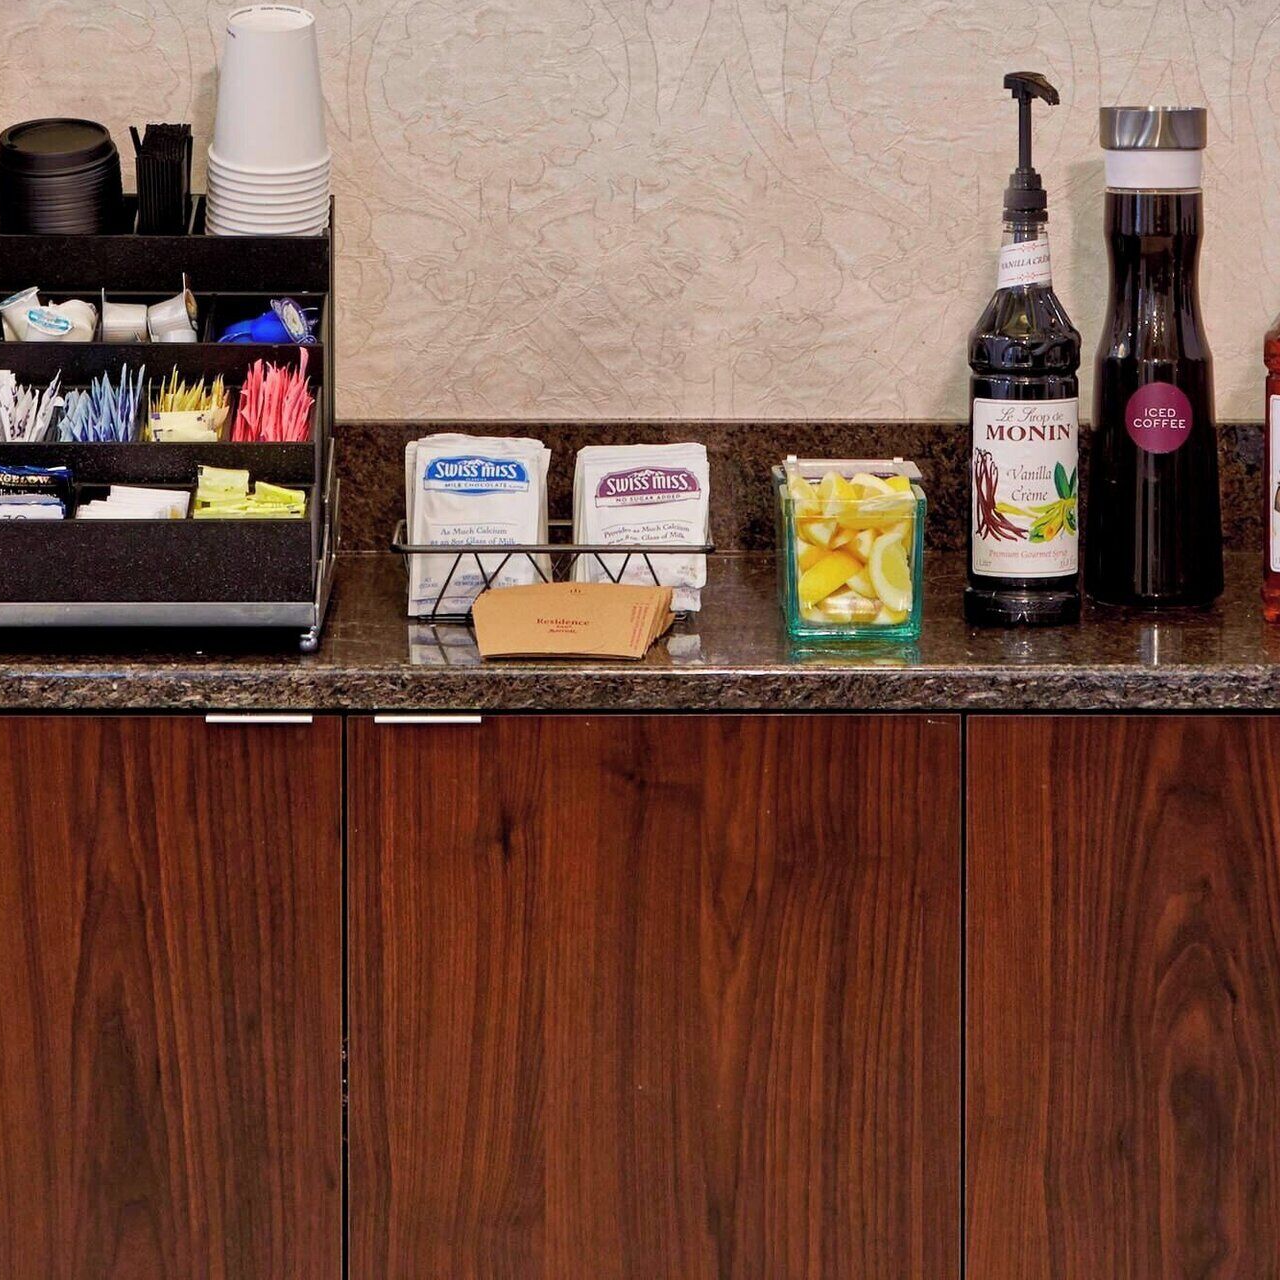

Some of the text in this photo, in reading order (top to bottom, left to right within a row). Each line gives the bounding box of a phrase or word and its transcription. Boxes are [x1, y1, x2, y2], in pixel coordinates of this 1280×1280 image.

[996, 406, 1064, 426] Le Sirop de
[1144, 407, 1176, 418] ICED
[1133, 418, 1186, 429] COFFEE
[986, 423, 1071, 441] MONIN
[1006, 465, 1052, 481] Vanilla
[1011, 485, 1048, 501] Crème
[452, 526, 474, 535] Much
[476, 526, 507, 535] Calcium
[536, 618, 590, 626] Residence
